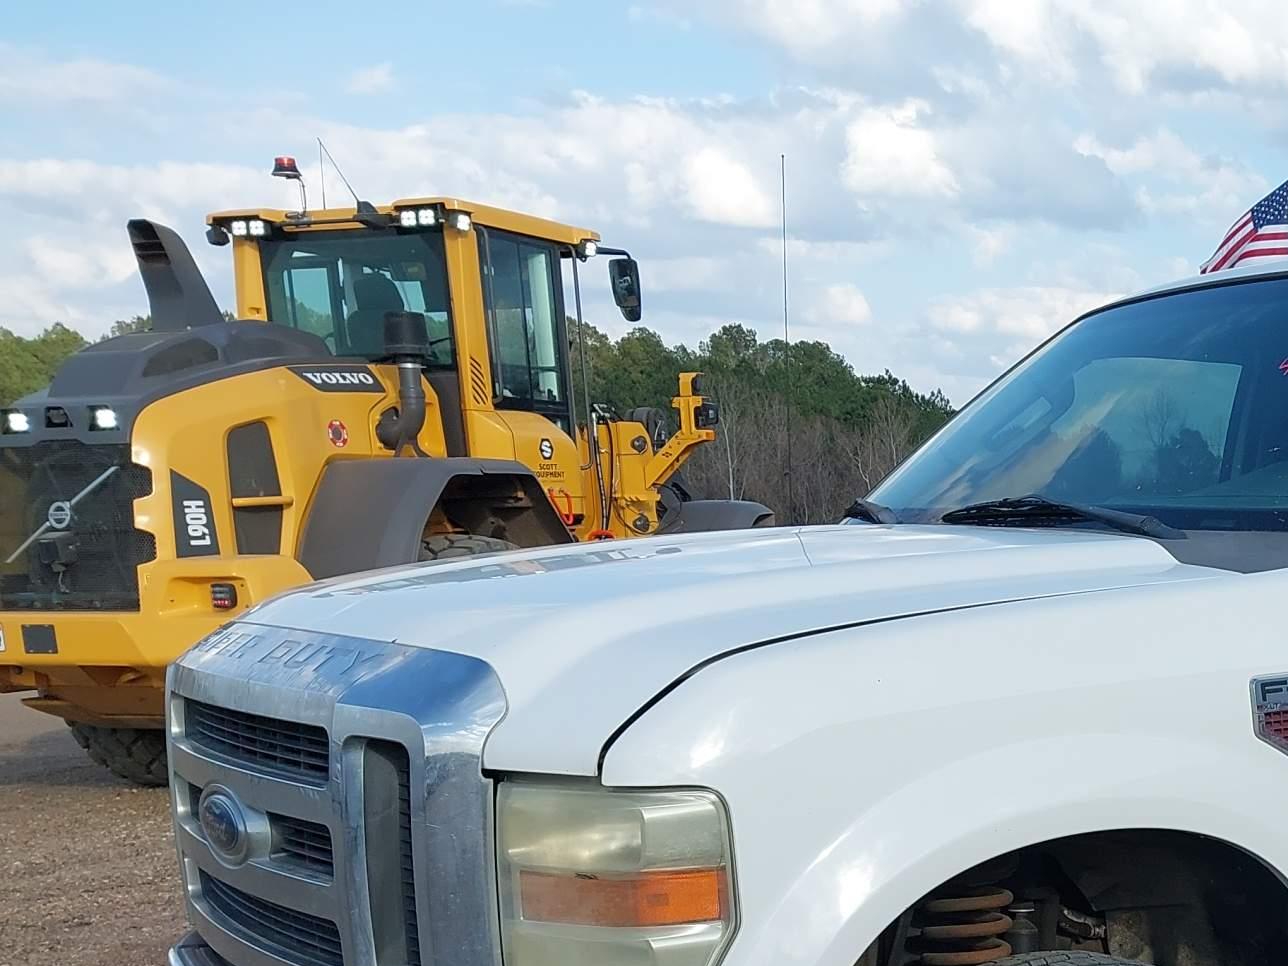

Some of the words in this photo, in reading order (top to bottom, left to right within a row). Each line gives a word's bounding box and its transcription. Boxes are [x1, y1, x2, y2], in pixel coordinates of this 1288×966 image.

[302, 371, 375, 385] VOLVO
[182, 500, 212, 546] L90H
[257, 639, 385, 676] DUTY
